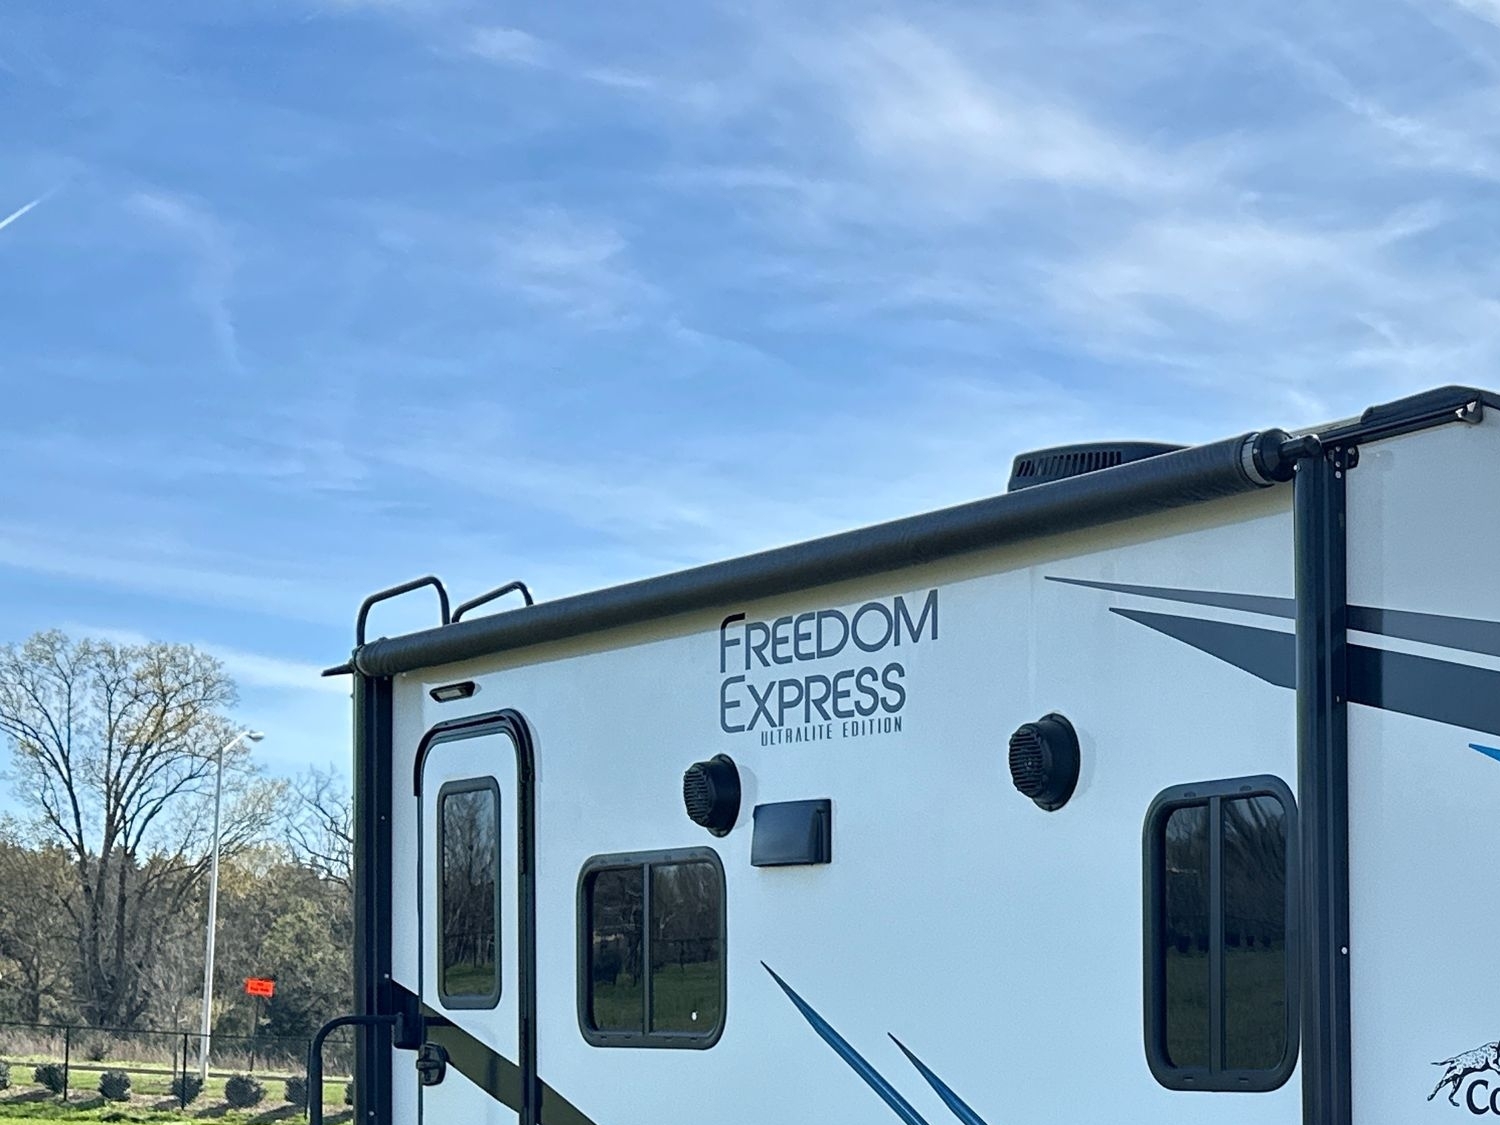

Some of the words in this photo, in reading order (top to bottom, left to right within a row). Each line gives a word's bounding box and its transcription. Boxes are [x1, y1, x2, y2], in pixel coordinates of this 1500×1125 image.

[720, 589, 939, 673] FREEDOM
[720, 662, 906, 734] EXPRESS
[761, 724, 833, 747] ULTRALITE
[843, 716, 903, 738] EDITION
